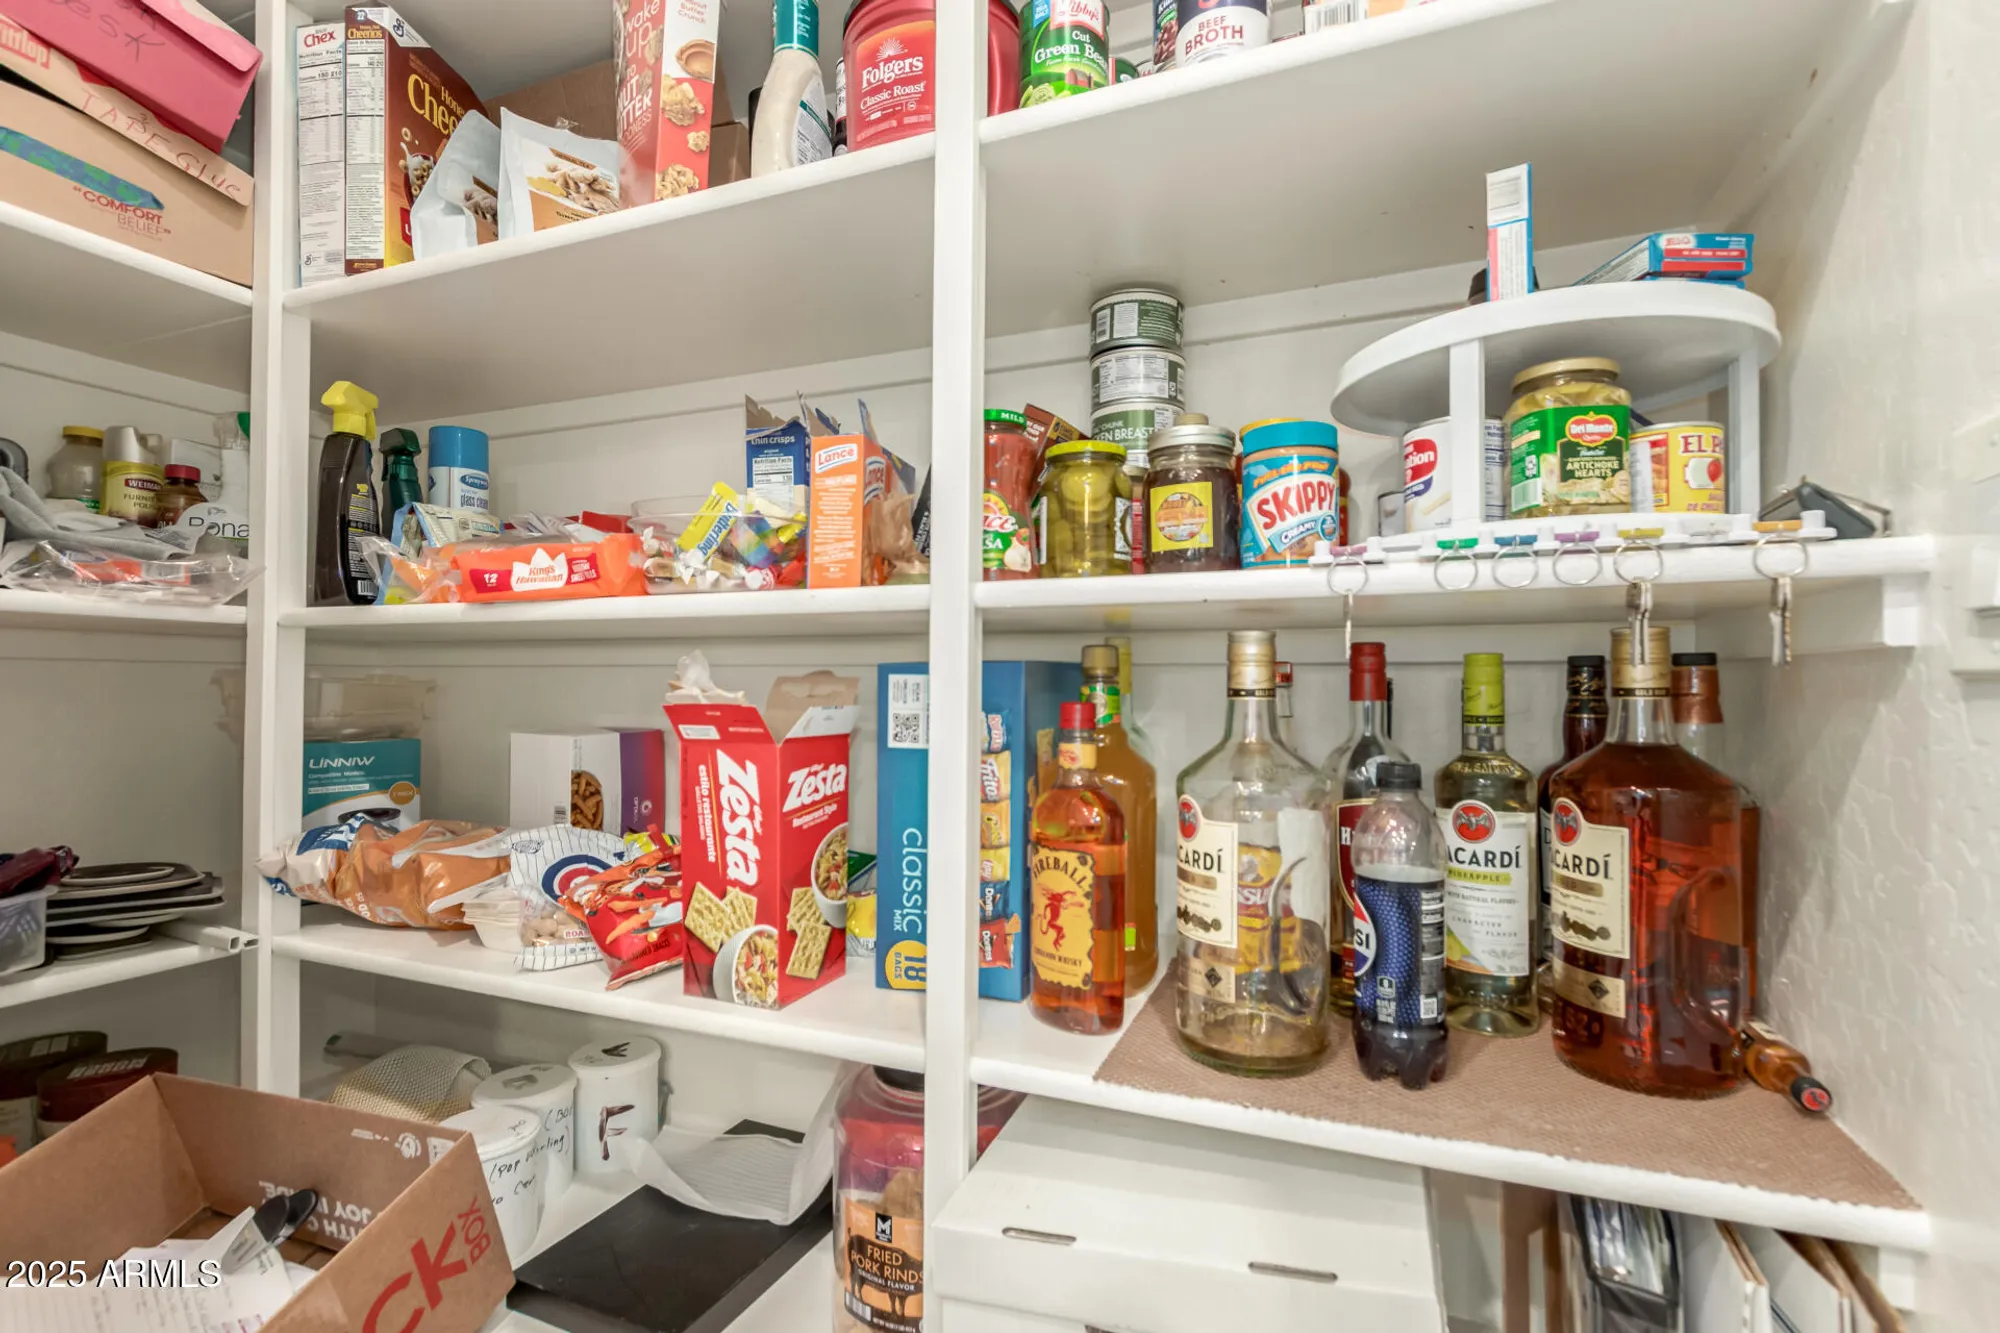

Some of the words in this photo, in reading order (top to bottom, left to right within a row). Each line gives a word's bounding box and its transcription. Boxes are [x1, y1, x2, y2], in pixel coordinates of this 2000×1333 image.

[347, 28, 383, 39] Cheerios
[1198, 16, 1226, 32] BEEF
[303, 31, 336, 48] Chex
[1072, 30, 1091, 43] Cut
[1185, 25, 1243, 56] BROTH
[1034, 44, 1080, 64] Green
[861, 56, 924, 89] Folgers
[860, 89, 892, 110] Classic
[893, 81, 927, 98] Roast
[1001, 412, 1025, 423] MILD
[1570, 423, 1585, 434] Del
[1586, 422, 1614, 433] Monte
[769, 436, 796, 444] crisps
[1114, 427, 1154, 440] BREAST
[1681, 434, 1708, 454] EL
[818, 448, 855, 466] Lance
[1566, 460, 1619, 471] ARTICHOKE
[1574, 468, 1613, 478] HEARTS
[1256, 480, 1336, 531] SKIPPY
[1281, 520, 1316, 544] CREAMY
[483, 572, 498, 583] 12
[516, 573, 564, 585] Hawaiian
[529, 563, 557, 577] King's
[698, 764, 710, 796] estilo
[782, 765, 848, 813] Zesta
[716, 748, 759, 887] Zesta
[703, 797, 716, 863] restaurante
[1178, 848, 1224, 873] CARDÍ
[1446, 845, 1522, 869] ACARDÍ
[1552, 853, 1614, 880] CARDÍ
[902, 827, 928, 934] classic
[893, 909, 902, 931] MIX
[893, 952, 902, 979] BAGS
[335, 1200, 372, 1226] JOY
[457, 1196, 491, 1266] BOX
[850, 1251, 880, 1275] PORK
[867, 1245, 903, 1266] FRIED
[857, 1268, 886, 1287] ORIGINAL
[887, 1280, 915, 1291] FLAVOR
